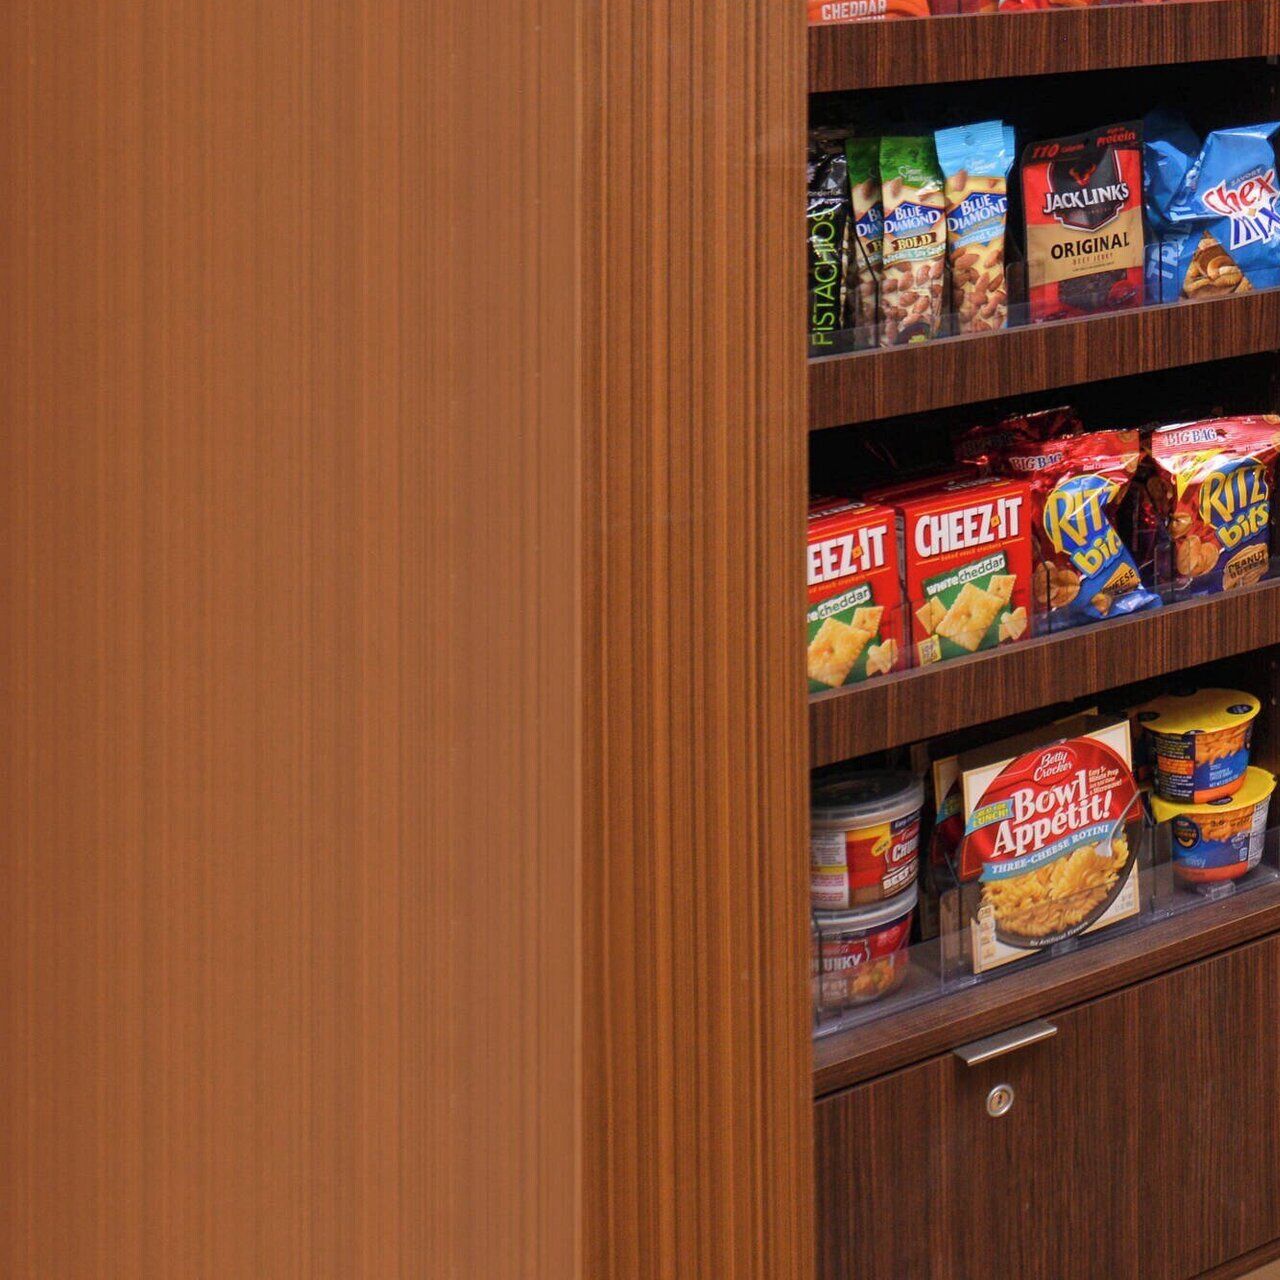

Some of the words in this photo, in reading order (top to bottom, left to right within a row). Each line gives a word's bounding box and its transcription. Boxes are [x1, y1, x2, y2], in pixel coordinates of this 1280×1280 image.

[961, 194, 992, 215] BLUE
[1043, 190, 1084, 213] JACK
[1203, 169, 1276, 216] Chex
[884, 210, 942, 235] DIAMOND
[895, 205, 923, 218] BLUE
[948, 196, 1008, 233] DIAMOND
[897, 234, 933, 252] BOLD
[1050, 231, 1130, 260] ORIGINAL
[1165, 429, 1190, 446] BIG
[1191, 427, 1217, 443] BAG
[1010, 456, 1036, 471] BIG
[1202, 465, 1268, 525] RITZ
[1217, 502, 1270, 548] bits
[807, 525, 888, 586] EEZ-IT
[1228, 550, 1266, 573] PEANUT
[959, 556, 1004, 583] cheddar
[818, 585, 870, 618] cheddar
[1033, 762, 1073, 782] Crocker
[1040, 751, 1068, 769] Betty
[1010, 769, 1088, 825] Bowl
[990, 790, 1113, 857] Appétit!
[991, 839, 1071, 875] THREE-CHEESE
[1072, 824, 1110, 843] ROTINI
